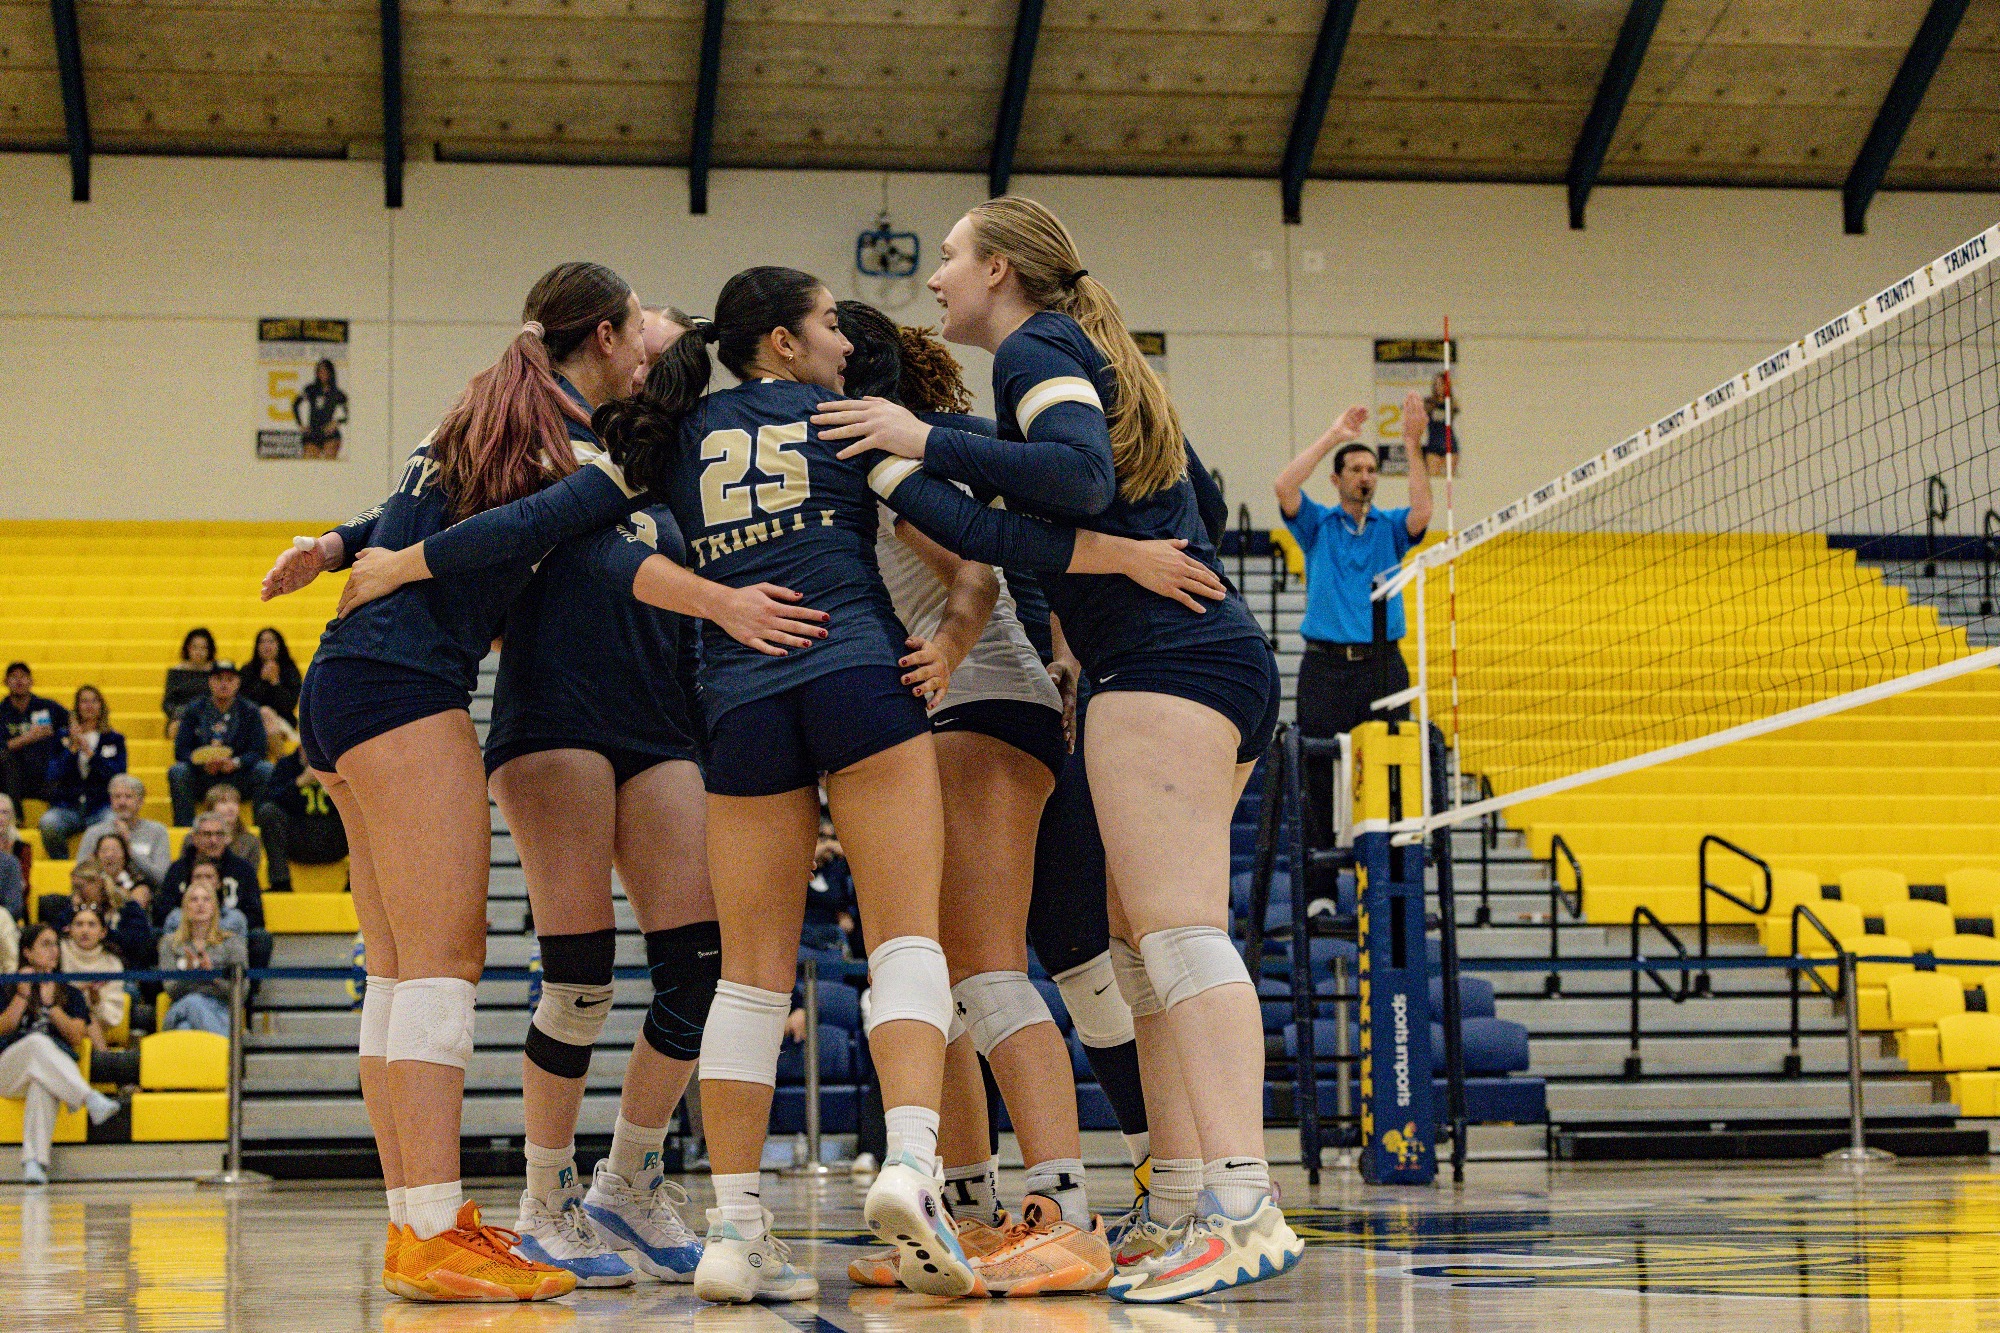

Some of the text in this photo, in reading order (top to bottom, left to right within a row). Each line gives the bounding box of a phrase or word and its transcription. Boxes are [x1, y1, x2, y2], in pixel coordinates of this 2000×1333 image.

[1814, 315, 1850, 348] TRINITY
[1876, 275, 1915, 313] TRINITY
[1924, 264, 1934, 286] T
[1943, 234, 1987, 273] TRINITY
[267, 371, 299, 421] 5
[700, 421, 810, 528] 25
[1356, 861, 1374, 1147] TRINITY
[1391, 993, 1412, 1107] sports imports
